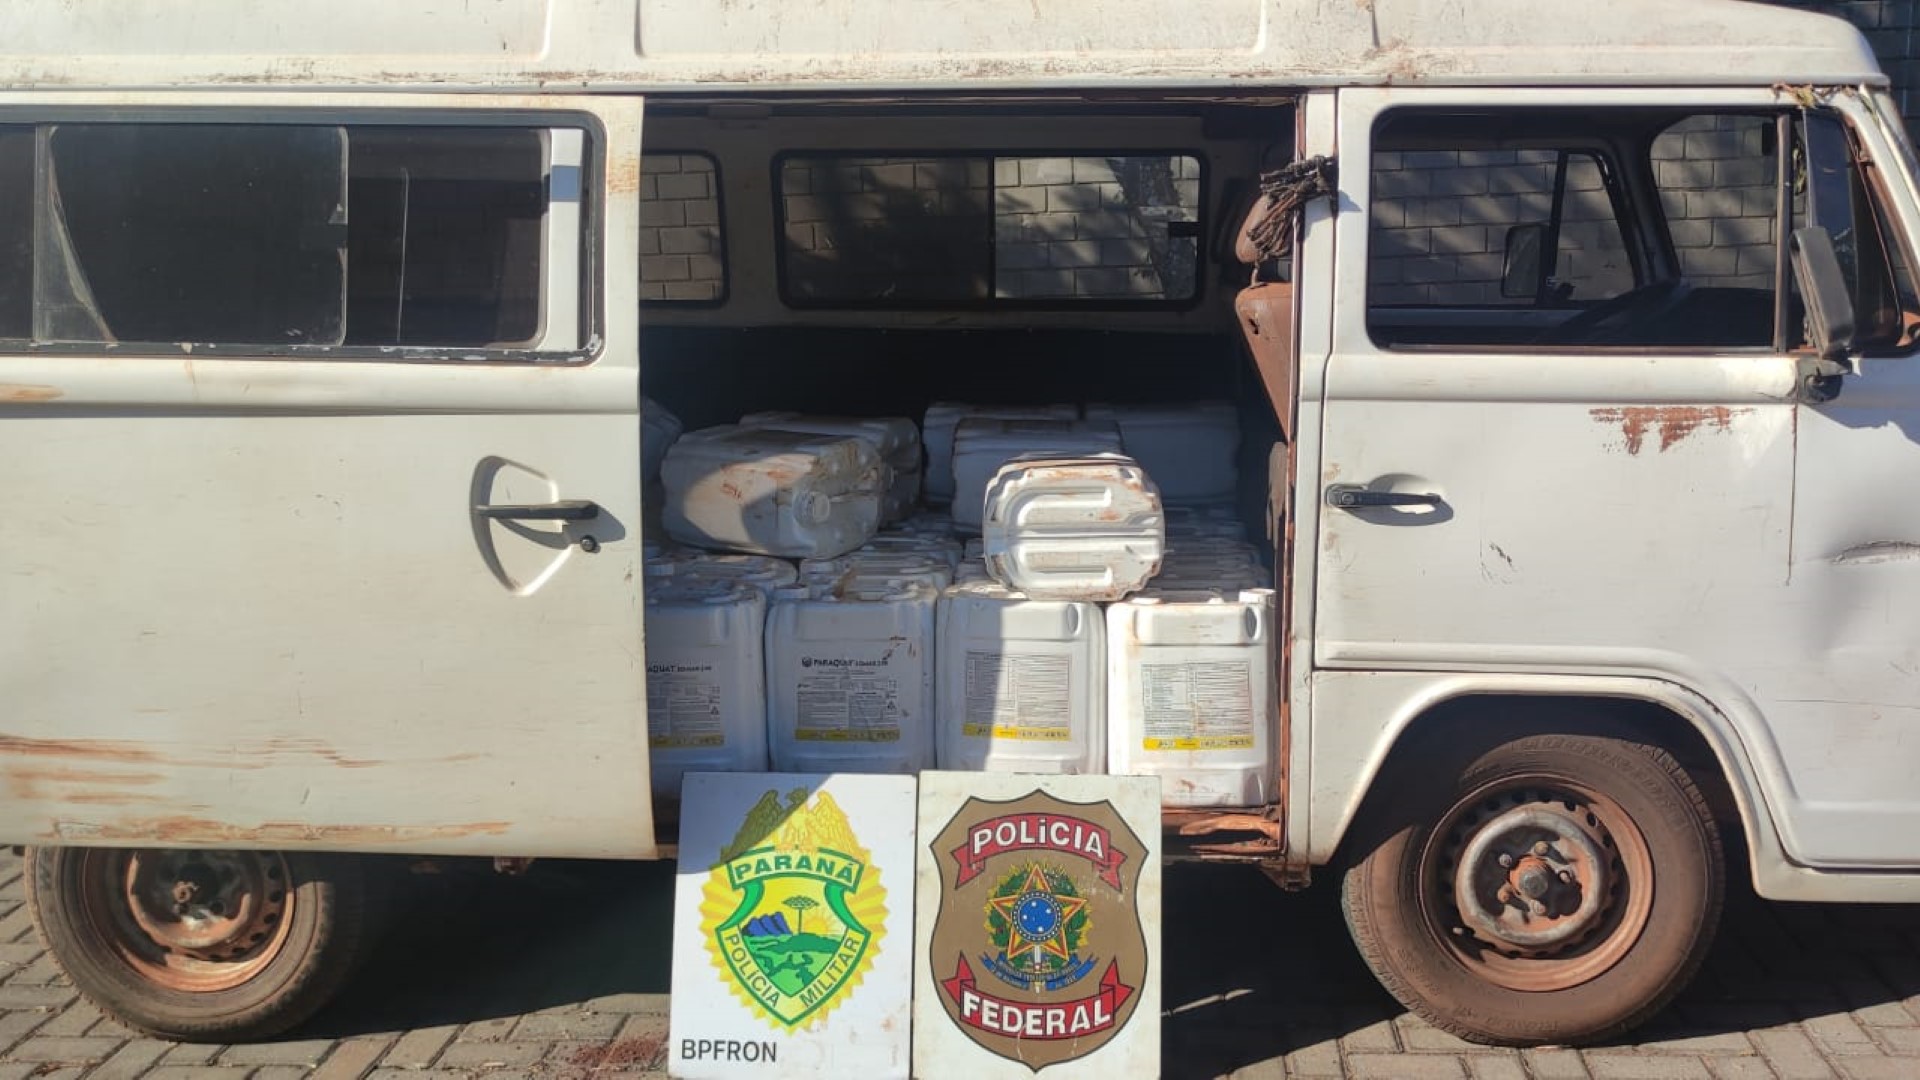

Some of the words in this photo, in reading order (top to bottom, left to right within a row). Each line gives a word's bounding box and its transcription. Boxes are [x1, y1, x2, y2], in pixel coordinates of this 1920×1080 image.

[735, 855, 853, 884] PARANÁ
[799, 937, 860, 1008] MILITAR
[963, 991, 1111, 1036] FEDERAL
[681, 1039, 777, 1062] BPFRON
